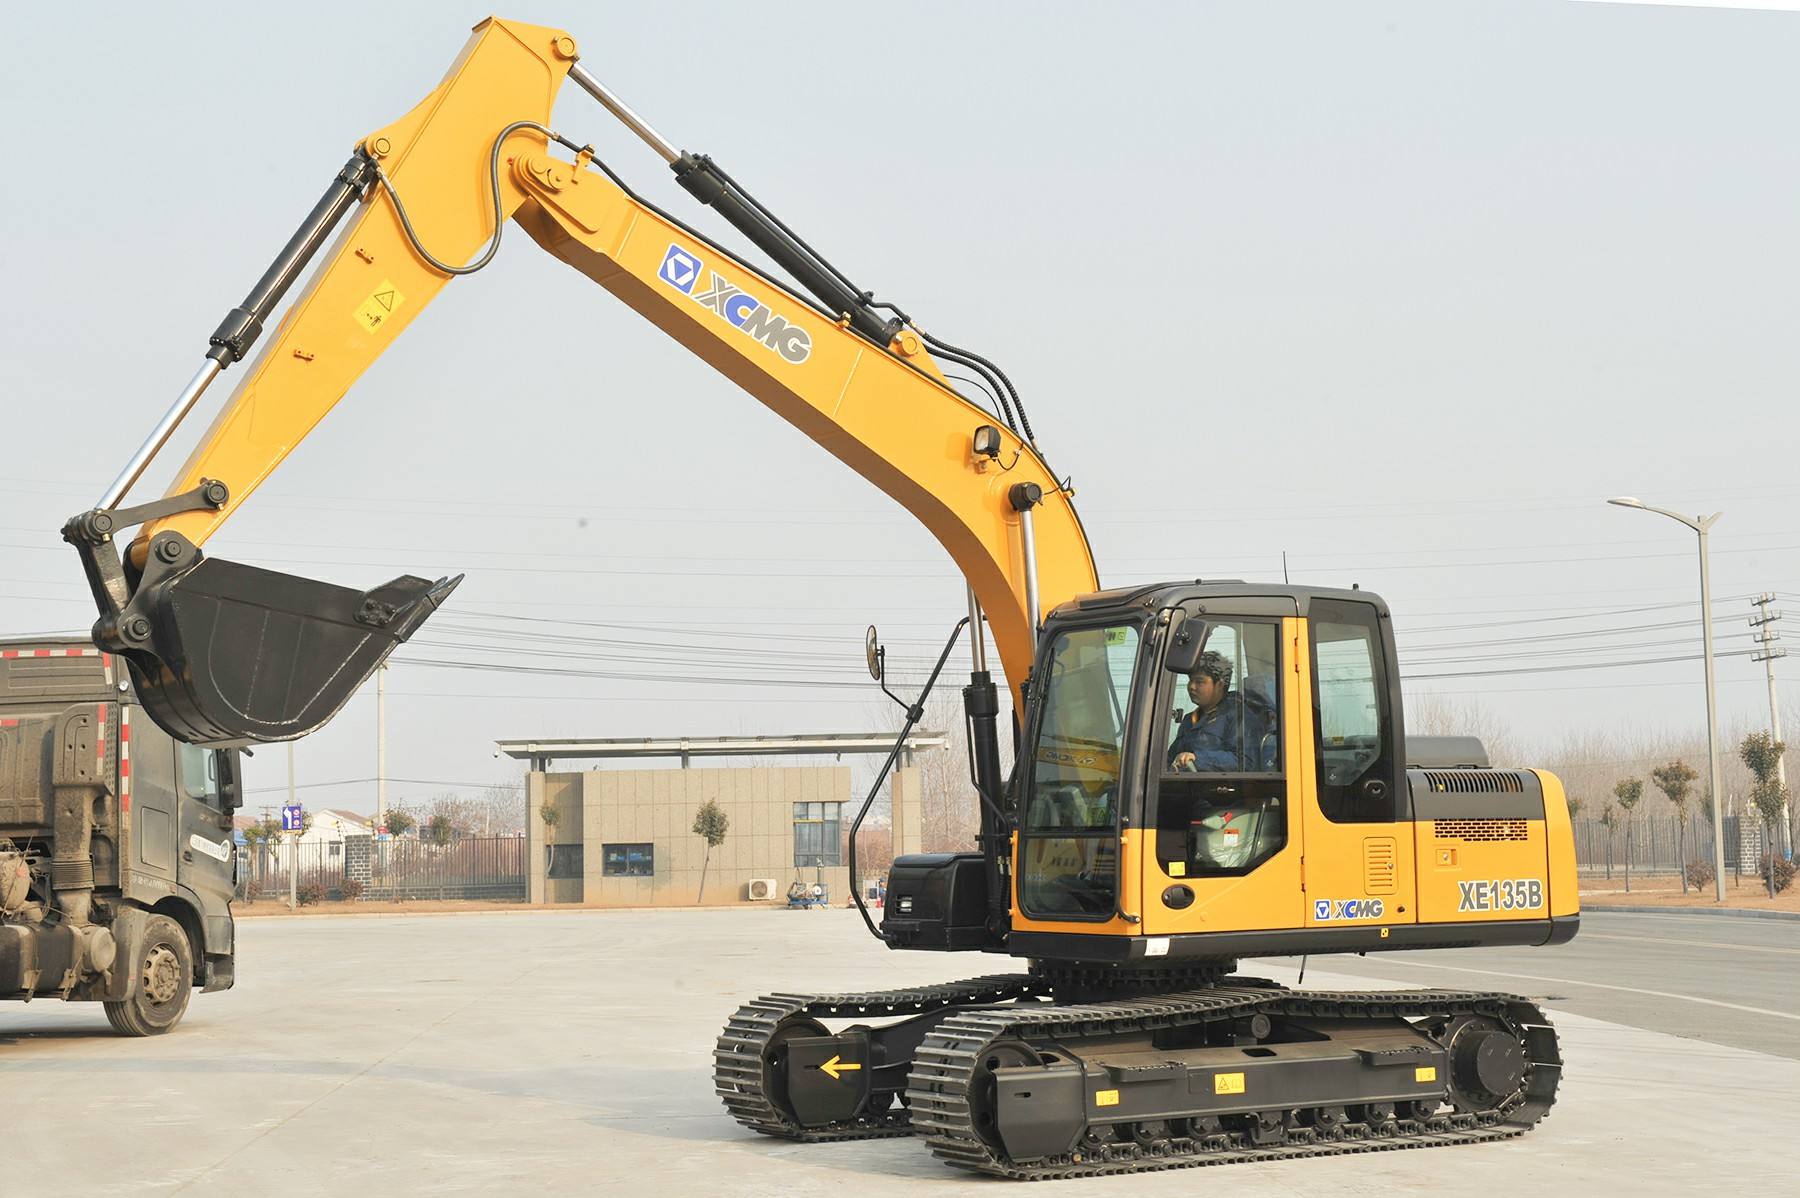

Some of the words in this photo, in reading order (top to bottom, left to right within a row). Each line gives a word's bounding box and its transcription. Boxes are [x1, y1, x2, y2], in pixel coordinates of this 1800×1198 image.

[693, 270, 812, 364] XCMG
[1334, 900, 1383, 918] XCMG
[1458, 879, 1543, 912] XE135B
